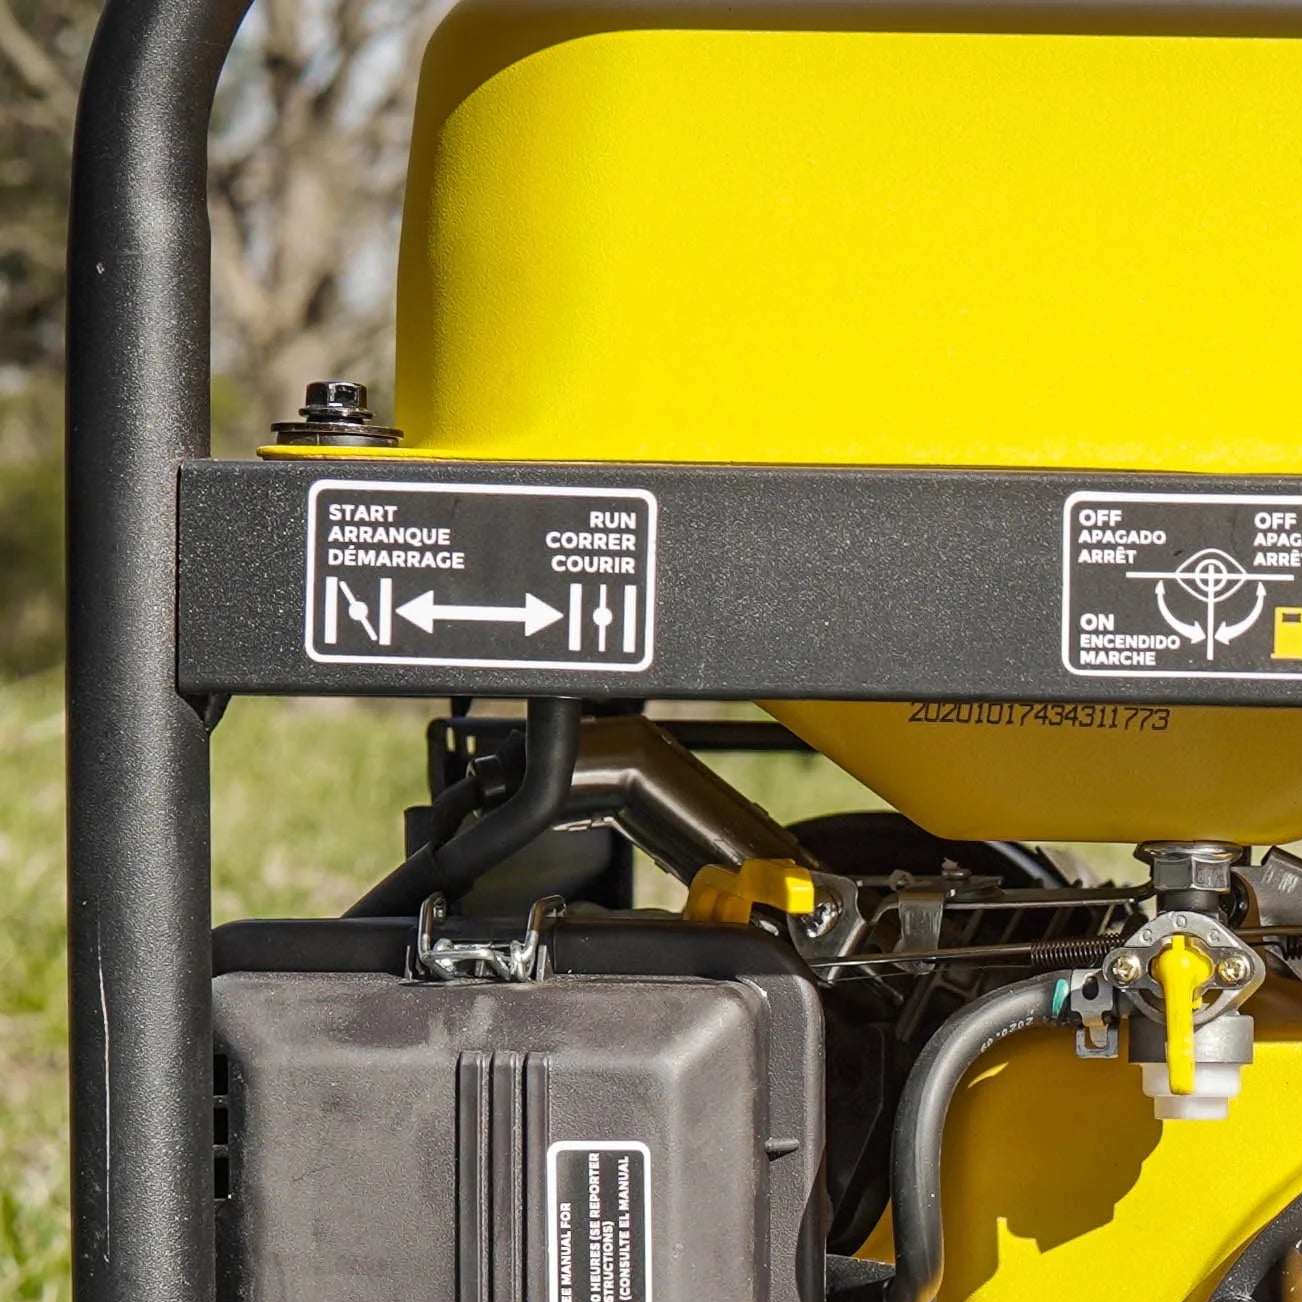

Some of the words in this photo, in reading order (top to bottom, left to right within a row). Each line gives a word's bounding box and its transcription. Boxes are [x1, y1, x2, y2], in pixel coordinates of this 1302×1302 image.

[328, 504, 398, 522] START
[590, 512, 637, 529] RUN
[1079, 509, 1122, 527] OFF
[1254, 512, 1297, 530] OFF
[328, 526, 451, 546] ARRANQUE
[545, 531, 636, 551] CORRER
[1078, 530, 1166, 545] APAGADO
[328, 546, 465, 569] DÉMARRAGE
[551, 555, 636, 574] COURIR
[1078, 547, 1137, 564] ARRÊT
[1080, 613, 1115, 632] ON
[1080, 634, 1181, 650] ENCENDIDO
[1080, 651, 1156, 666] MARCHE
[908, 701, 1171, 731] 20201017434311773
[588, 1153, 600, 1218] REPORTER
[618, 1156, 629, 1210] MANUAL
[560, 1203, 571, 1228] FOR
[618, 1213, 629, 1228] EL
[589, 1221, 601, 1240] (SE
[560, 1231, 571, 1285] MANUAL
[590, 1243, 601, 1291] HEURES
[619, 1231, 631, 1300] (CONSULTE
